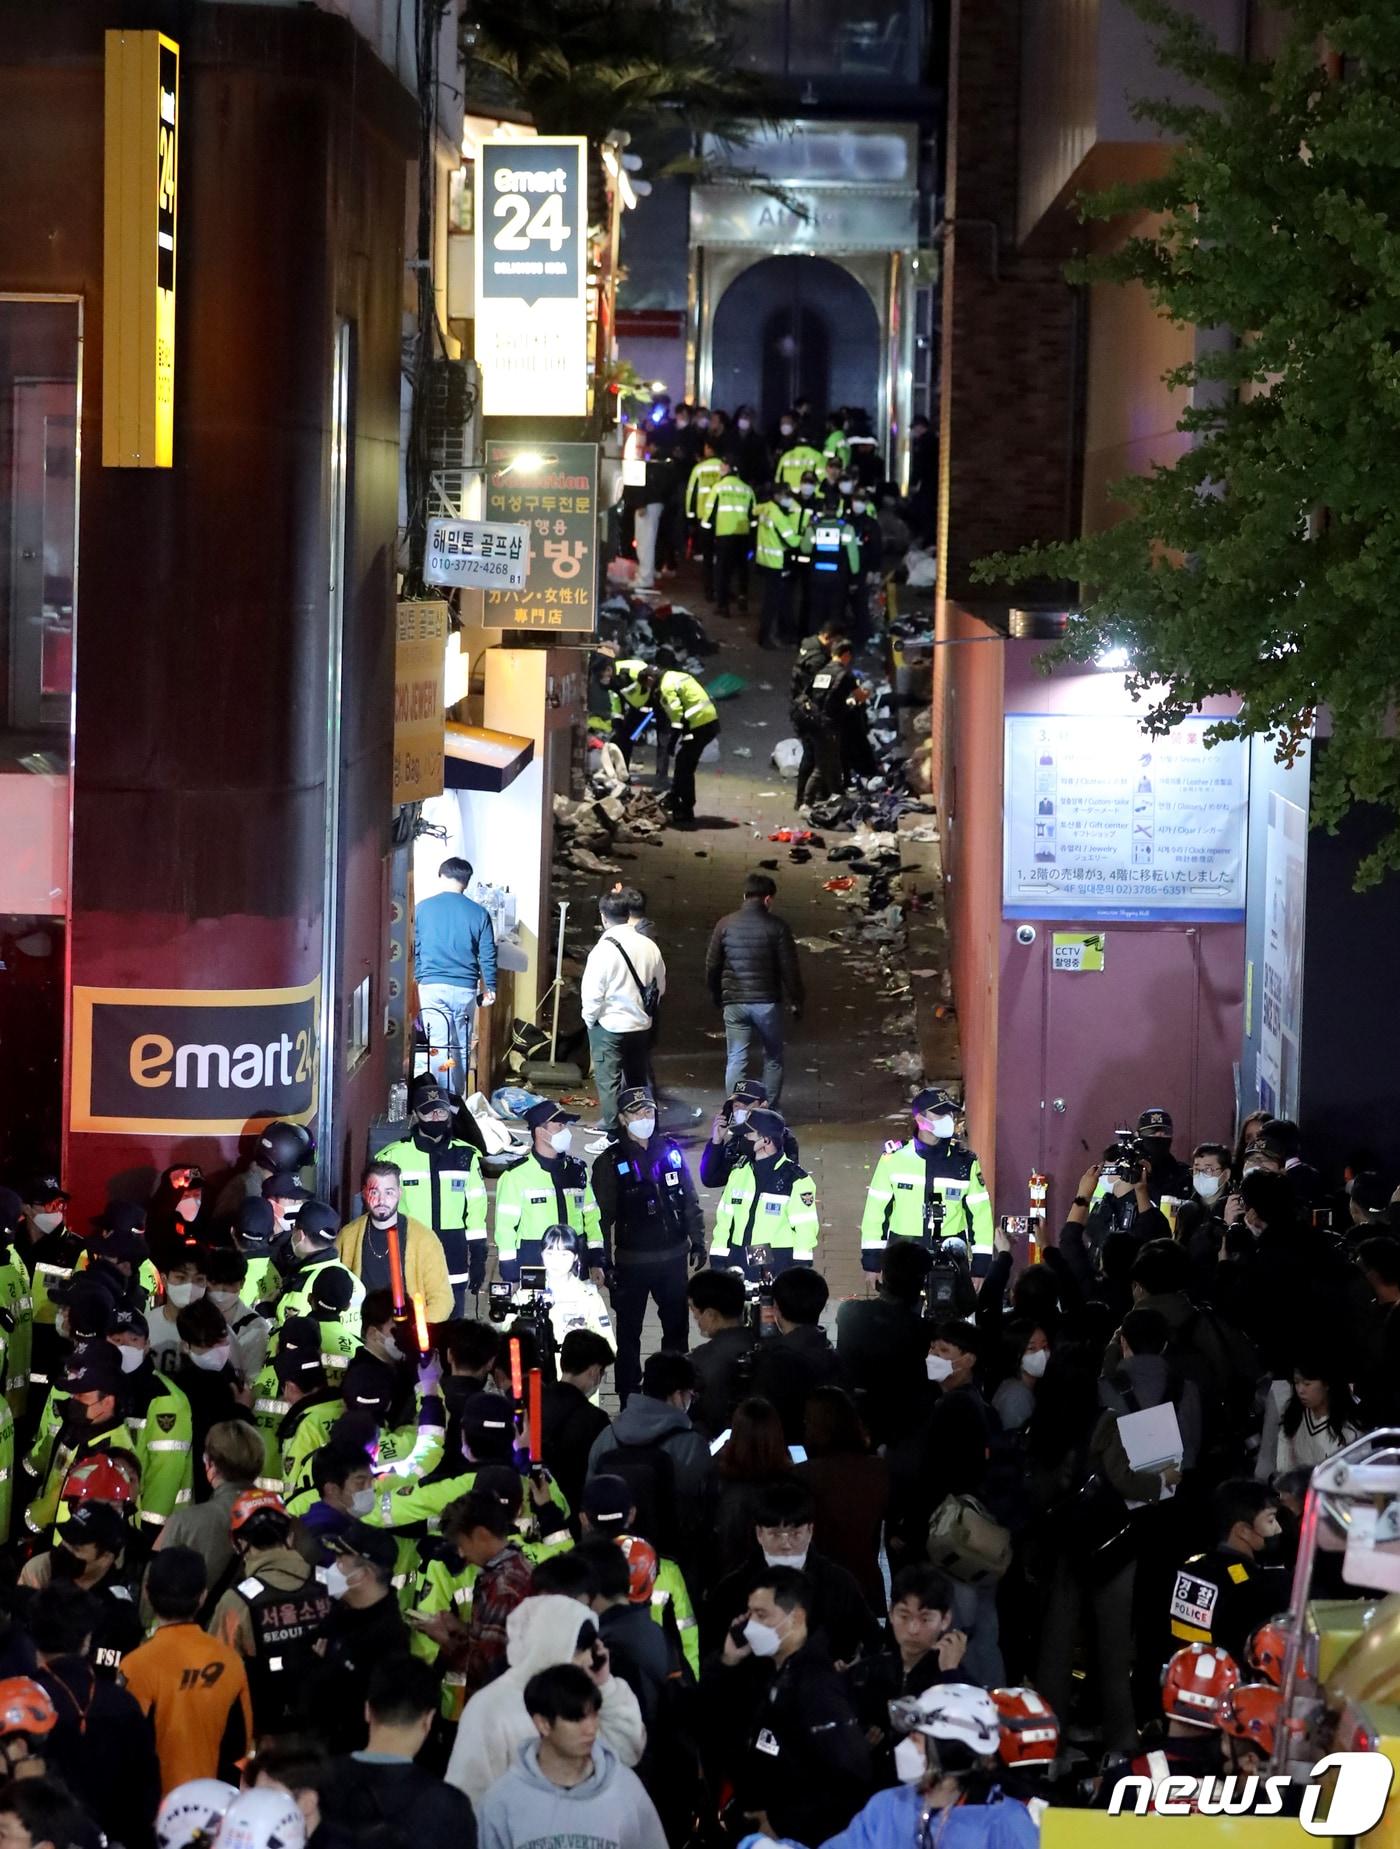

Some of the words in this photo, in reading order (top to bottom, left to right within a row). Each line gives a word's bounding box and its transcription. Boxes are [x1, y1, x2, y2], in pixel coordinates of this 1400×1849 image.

[493, 194, 571, 251] 24
[491, 495, 590, 514] 여성구두전문
[433, 530, 474, 555] 해밀톤
[481, 533, 523, 560] 골프샵
[431, 557, 509, 575] 010-3772-4268
[509, 575, 521, 584] B1
[1089, 821, 1103, 829] Gift
[1177, 826, 1195, 835] Cigar
[1088, 845, 1118, 854] Jewelry
[1064, 885, 1075, 893] 4F
[1078, 884, 1114, 894] 임대문의
[1055, 947, 1080, 956] CCTV
[1055, 957, 1080, 968] 촬영중
[129, 1033, 293, 1089] emart
[1175, 1602, 1208, 1622] POLICE
[179, 1662, 225, 1691] 119
